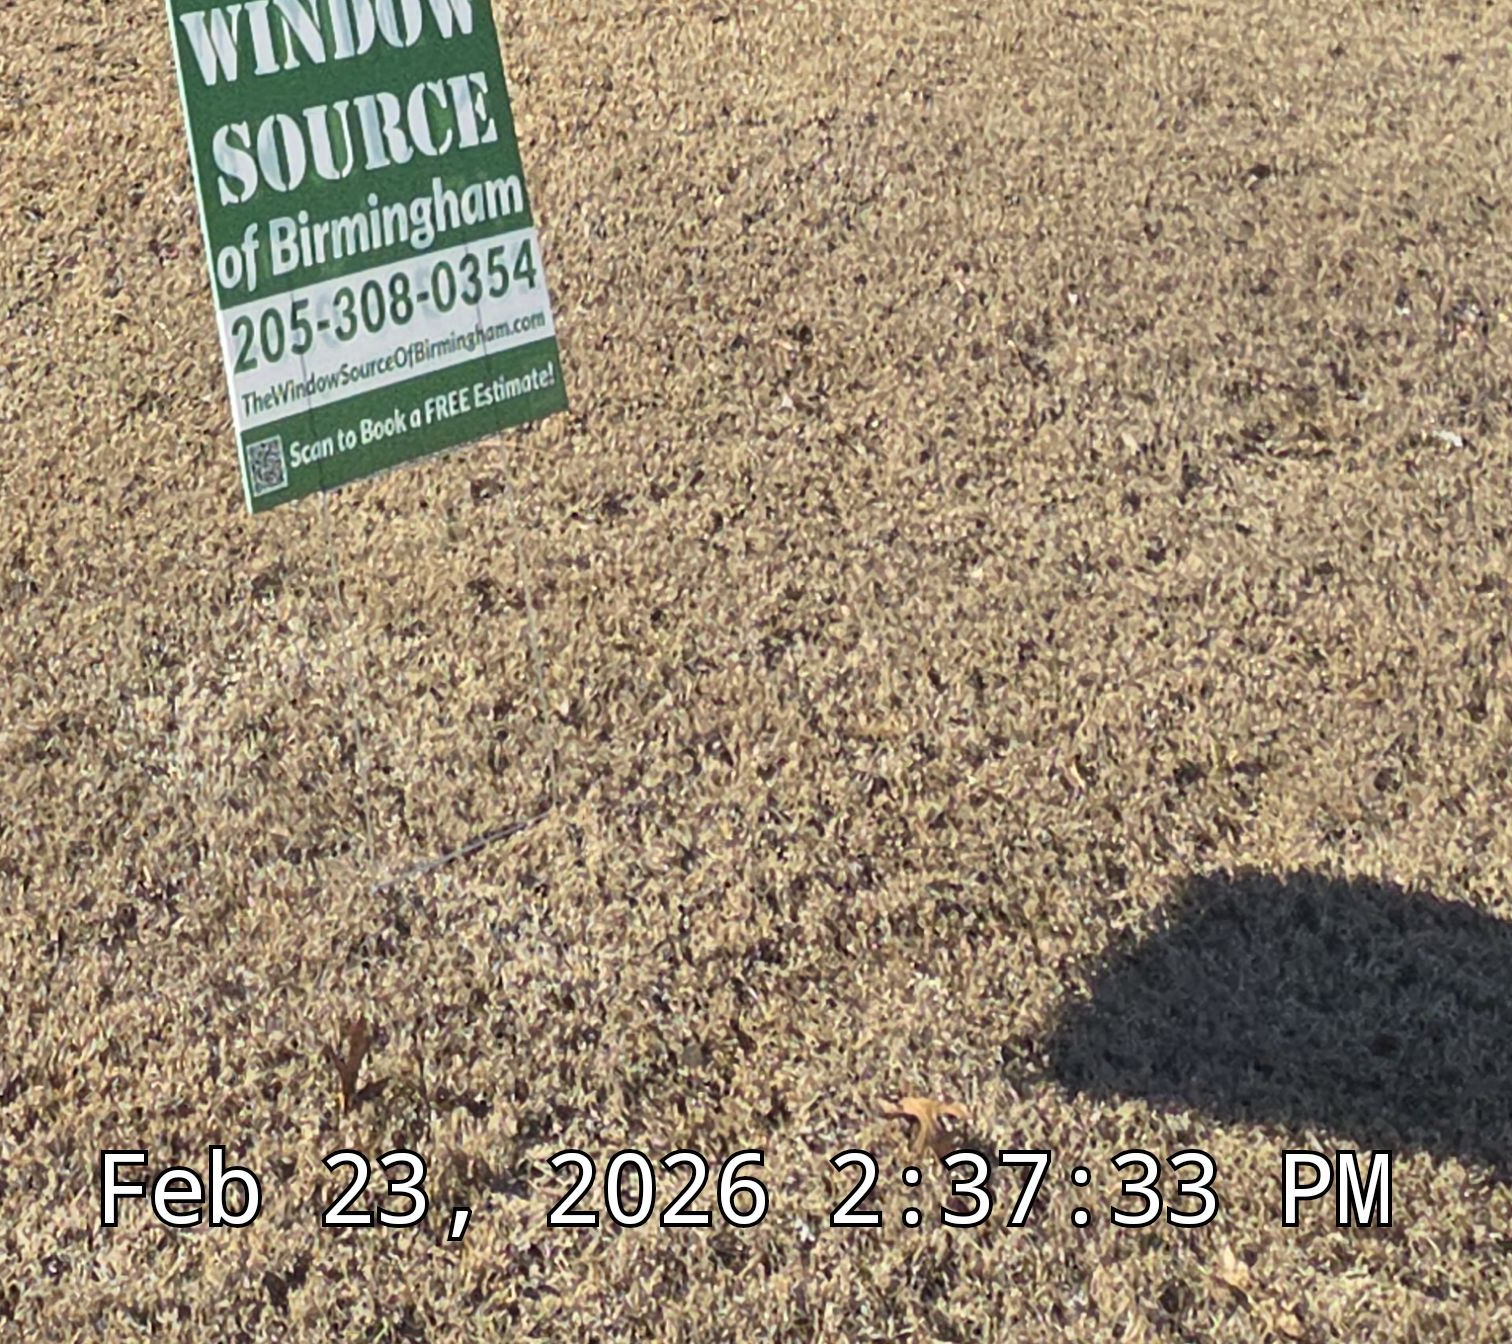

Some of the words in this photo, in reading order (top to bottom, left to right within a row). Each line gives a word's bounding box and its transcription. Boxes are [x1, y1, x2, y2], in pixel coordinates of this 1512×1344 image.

[212, 71, 497, 205] SOURCE
[217, 223, 259, 292] of
[269, 175, 524, 276] Birmingham
[232, 238, 537, 373] 205-308-0354
[242, 310, 546, 417] TheWindowSourceOfBirmingham.com
[289, 435, 334, 467] Scan
[337, 428, 357, 452] to
[359, 409, 406, 445] Book
[410, 408, 421, 427] a
[424, 387, 471, 425] FREE
[473, 361, 555, 409] Estimate!
